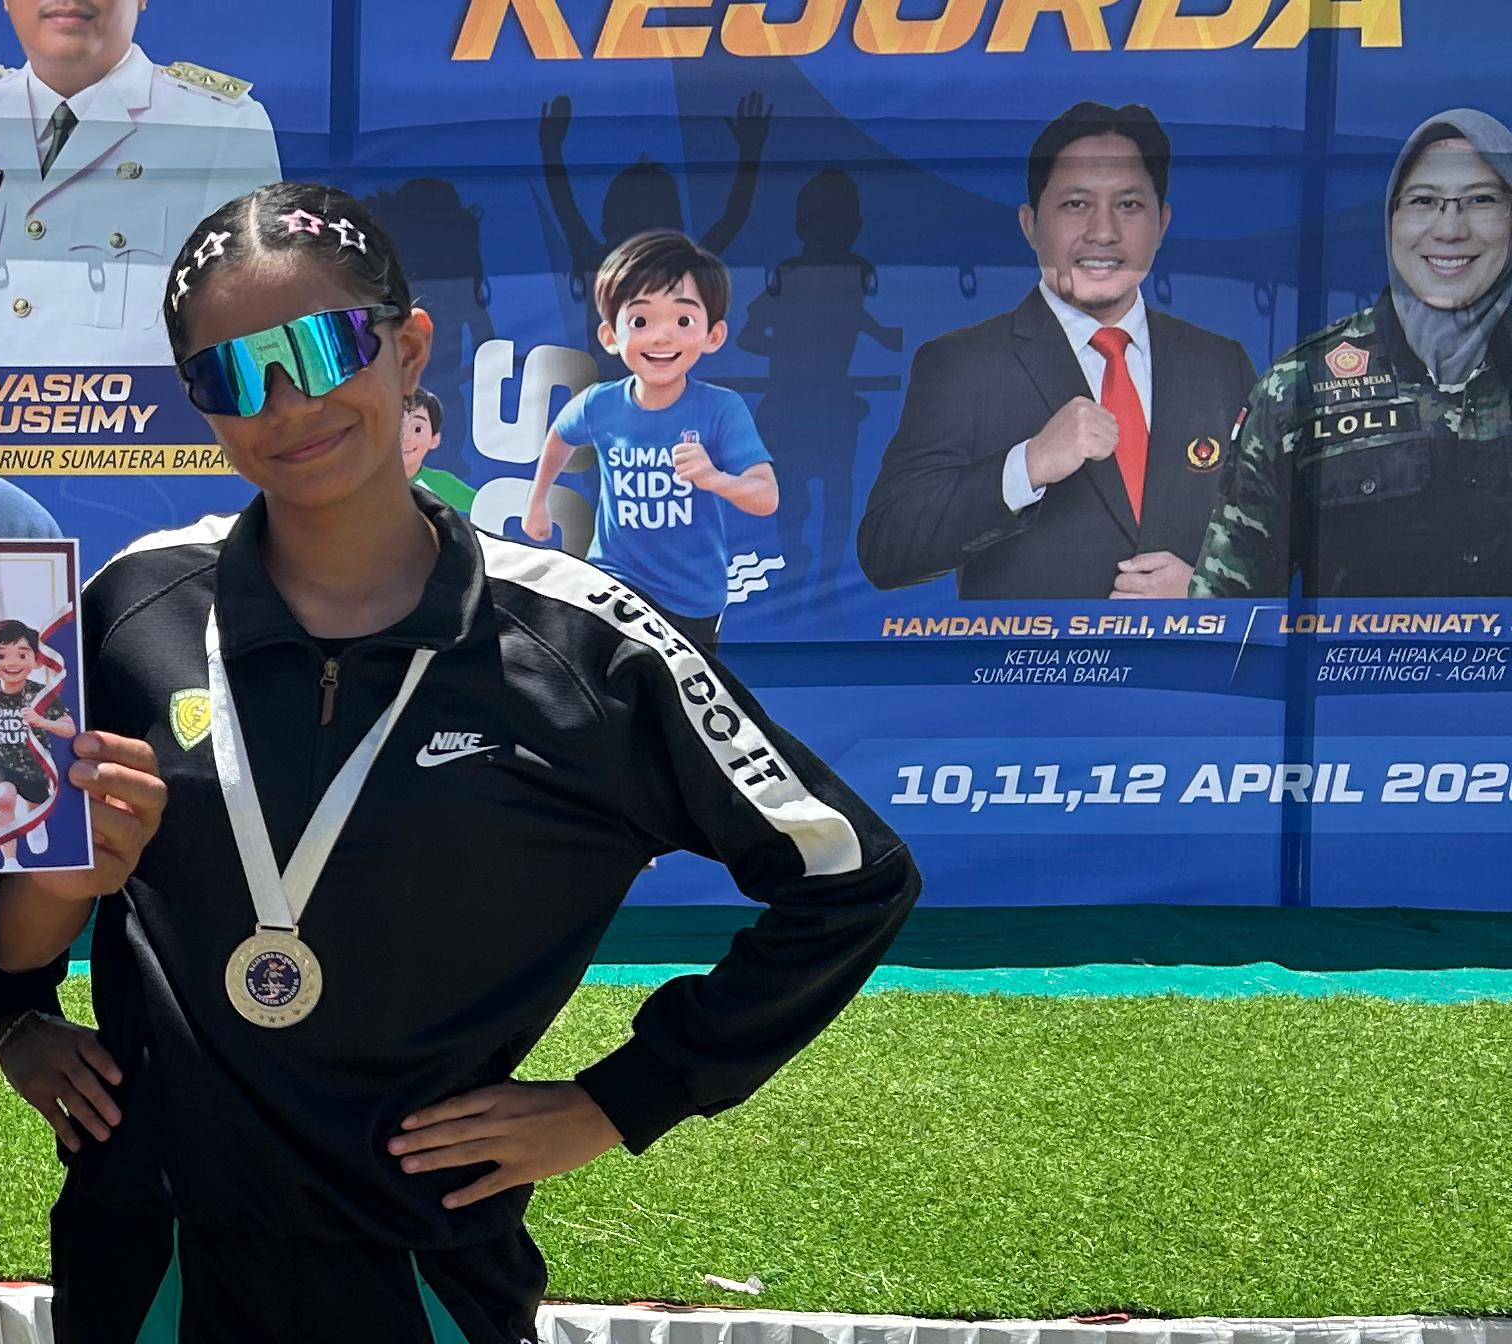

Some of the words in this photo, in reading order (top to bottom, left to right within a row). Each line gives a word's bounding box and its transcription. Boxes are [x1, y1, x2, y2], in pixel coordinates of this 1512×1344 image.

[1313, 409, 1398, 439] LOLI
[59, 449, 165, 469] SUMATERA
[172, 449, 232, 469] BARA
[607, 447, 676, 468] SUMA
[613, 469, 694, 499] KIDS
[617, 498, 694, 529] RUN
[881, 615, 1059, 640] HAMDANUS,
[1163, 614, 1227, 636] M.Si
[1278, 614, 1343, 635] LOLI
[1349, 613, 1502, 637] KURNIATY,
[1004, 649, 1060, 666] KETUA
[1066, 649, 1111, 666] KONI
[1325, 647, 1382, 663] KETUA
[1388, 647, 1467, 663] HIPAKAD
[1471, 647, 1510, 663] DPC
[971, 667, 1068, 684] SUMATERA
[1072, 666, 1133, 683] BARAT
[1316, 665, 1431, 683] BUKITTINGGI
[1445, 665, 1507, 682] AGAM
[586, 585, 695, 658] JUST
[680, 671, 741, 742] DO
[728, 746, 788, 787] IT
[428, 731, 484, 750] NIKE
[890, 763, 1167, 813] 10,11,12
[1178, 763, 1364, 804] APRIL
[1381, 762, 1512, 804] 202
